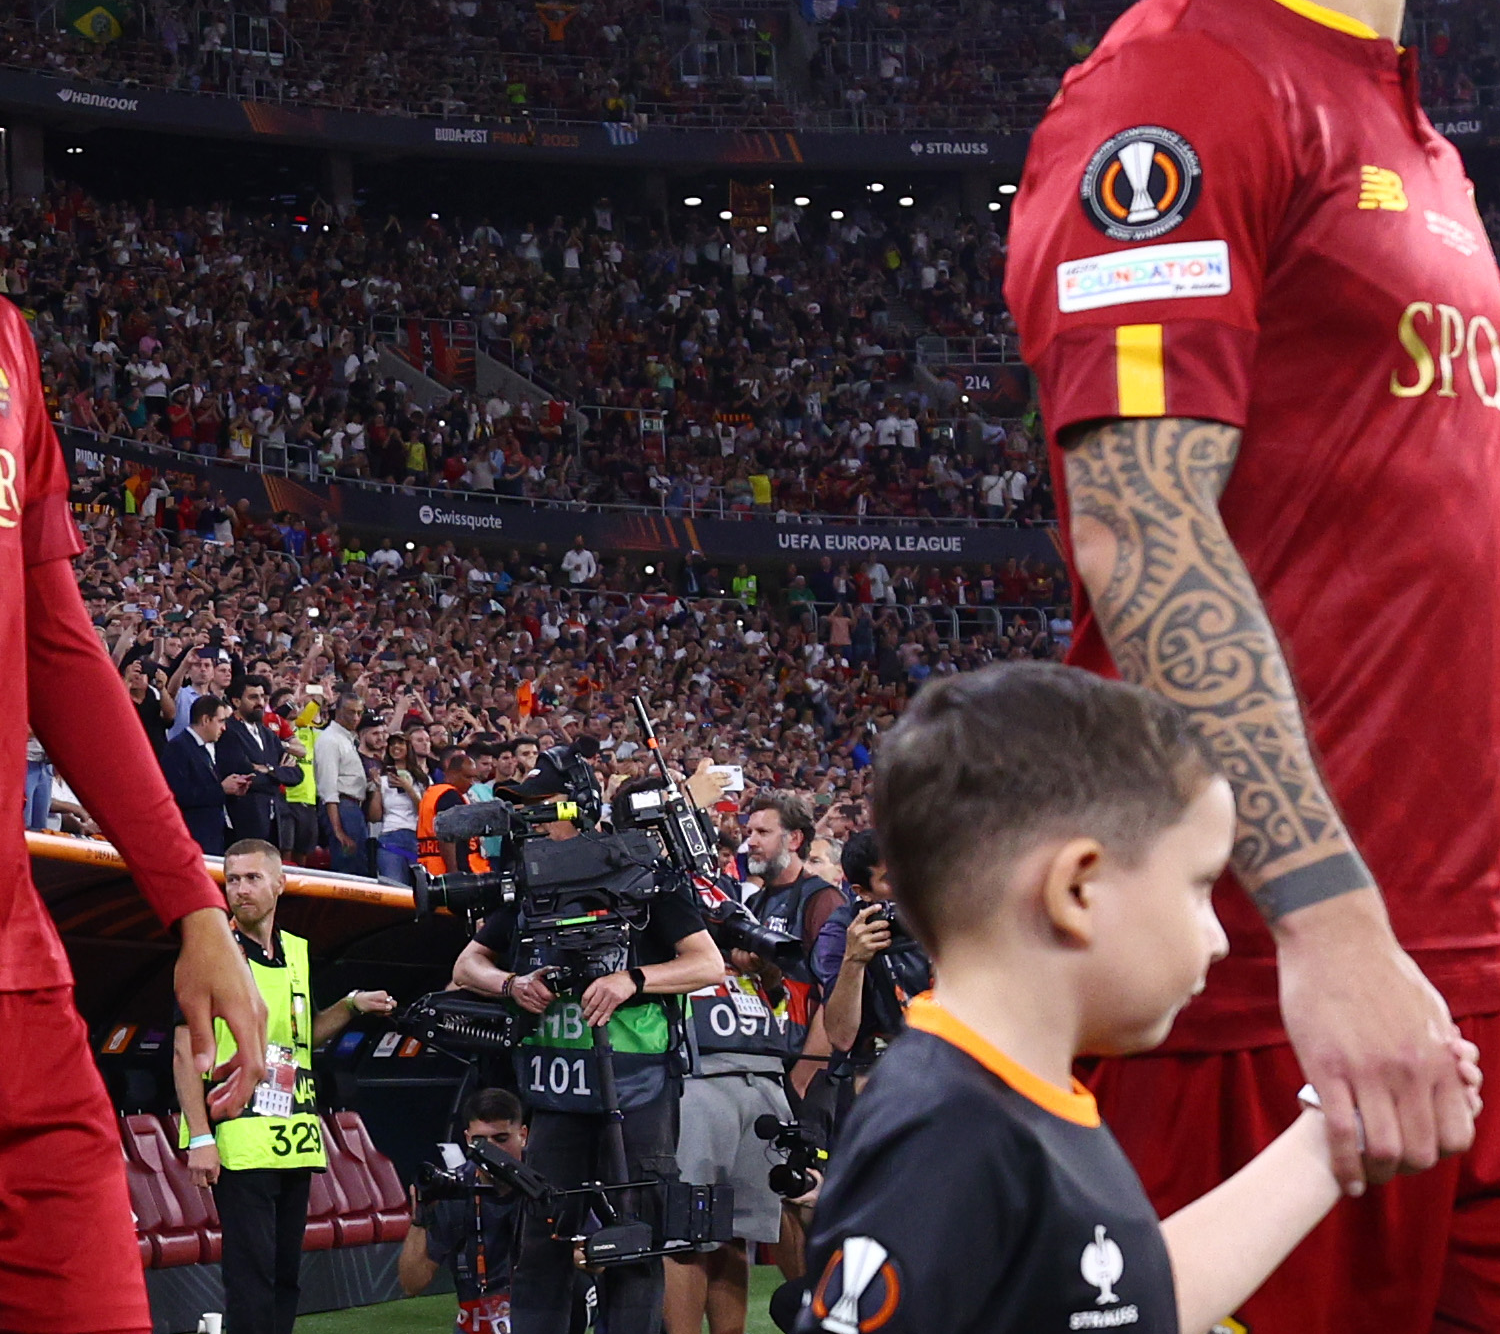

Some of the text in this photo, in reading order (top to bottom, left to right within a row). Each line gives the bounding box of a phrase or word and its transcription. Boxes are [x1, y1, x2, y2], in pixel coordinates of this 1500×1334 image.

[1434, 119, 1480, 136] EAGU
[492, 130, 533, 146] FINA
[541, 133, 580, 148] 2023
[925, 142, 989, 155] STRAUSS
[1065, 253, 1223, 295] FOUNDATION
[964, 375, 991, 390] 214
[434, 507, 503, 531] Swissquote
[778, 532, 962, 552] UEFA EUROPA LEAGUE
[529, 1053, 592, 1097] 101
[269, 1121, 322, 1157] 329
